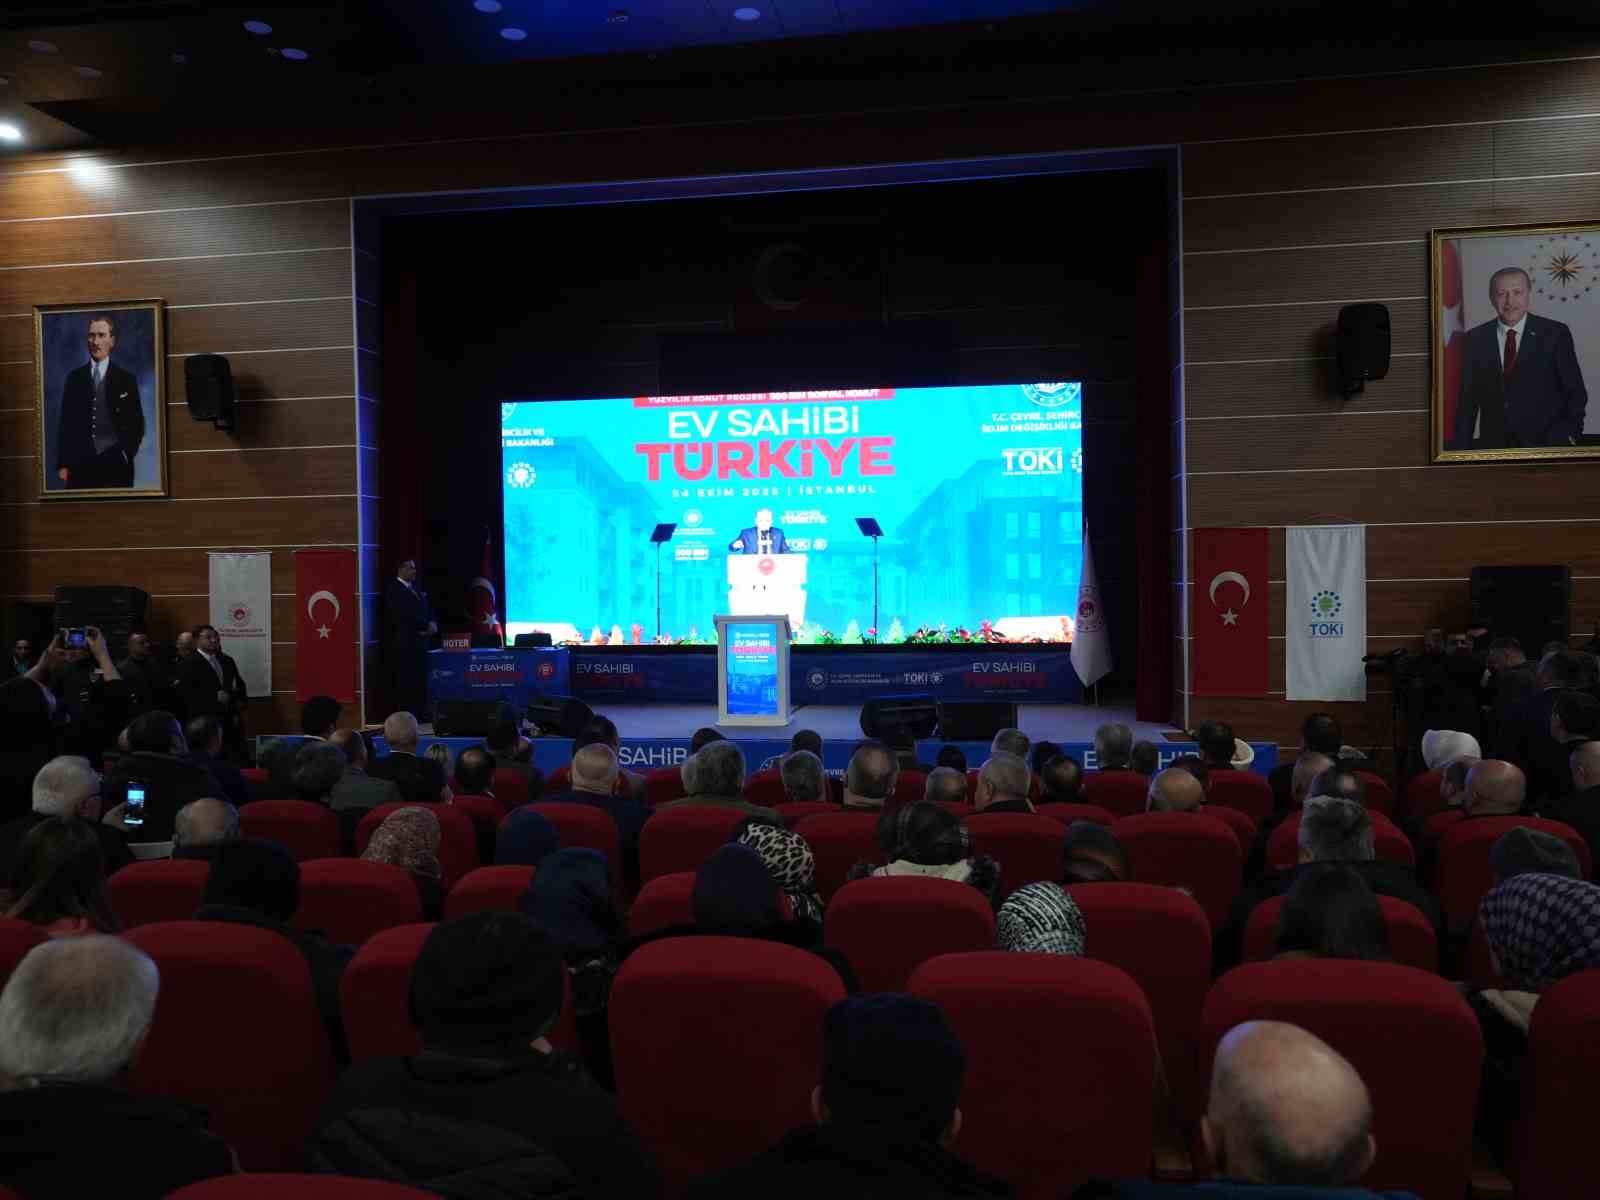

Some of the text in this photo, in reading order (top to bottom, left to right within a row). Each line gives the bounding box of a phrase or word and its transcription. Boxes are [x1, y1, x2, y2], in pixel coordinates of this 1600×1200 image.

[668, 405, 859, 439] EV SAHİBİ
[634, 436, 896, 481] TÜRKİYE
[618, 746, 688, 765] SAHİB
